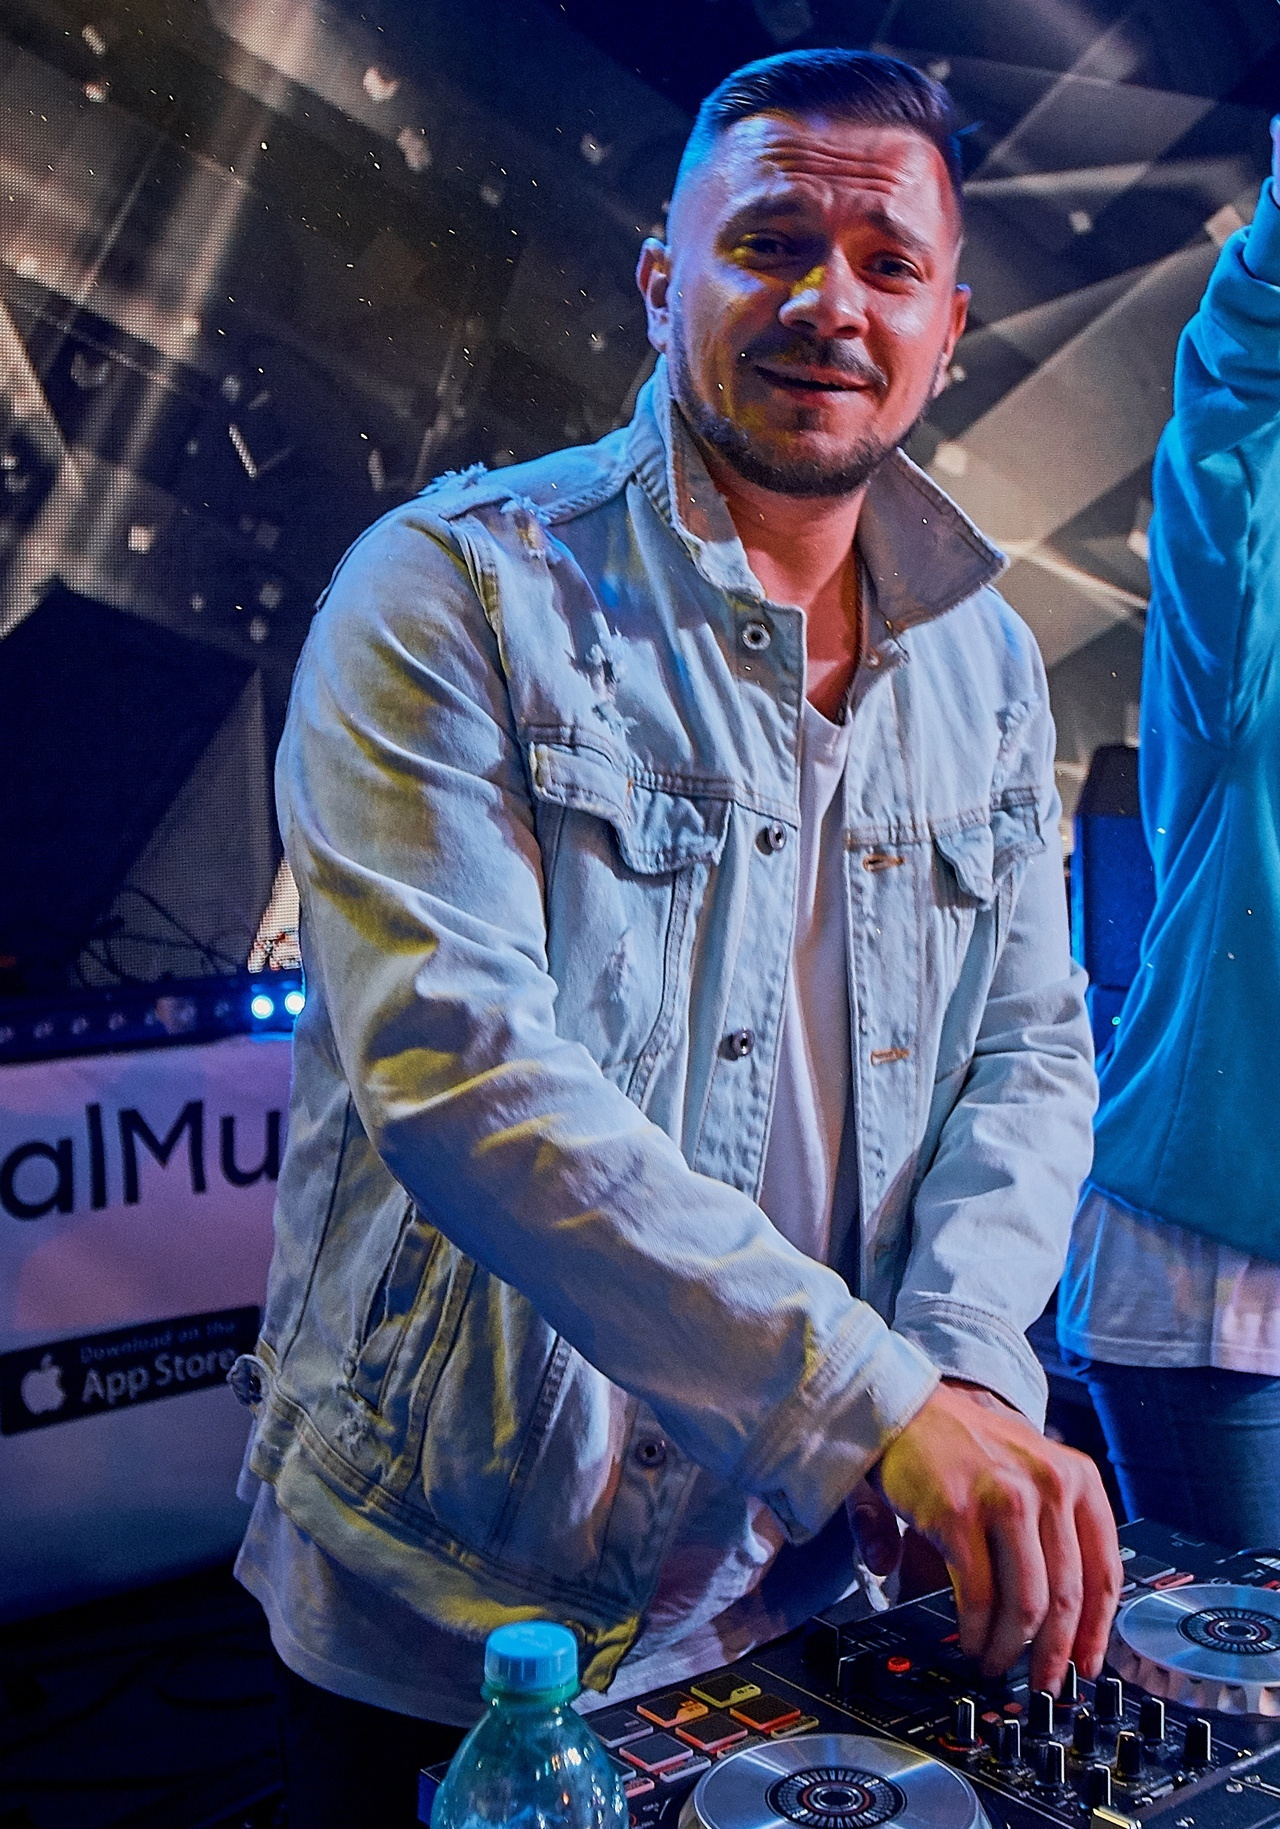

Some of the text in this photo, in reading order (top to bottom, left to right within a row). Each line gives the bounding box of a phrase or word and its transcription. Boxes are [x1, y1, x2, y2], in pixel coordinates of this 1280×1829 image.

[80, 1317, 237, 1364] Download on the
[81, 1346, 239, 1405] App Store
